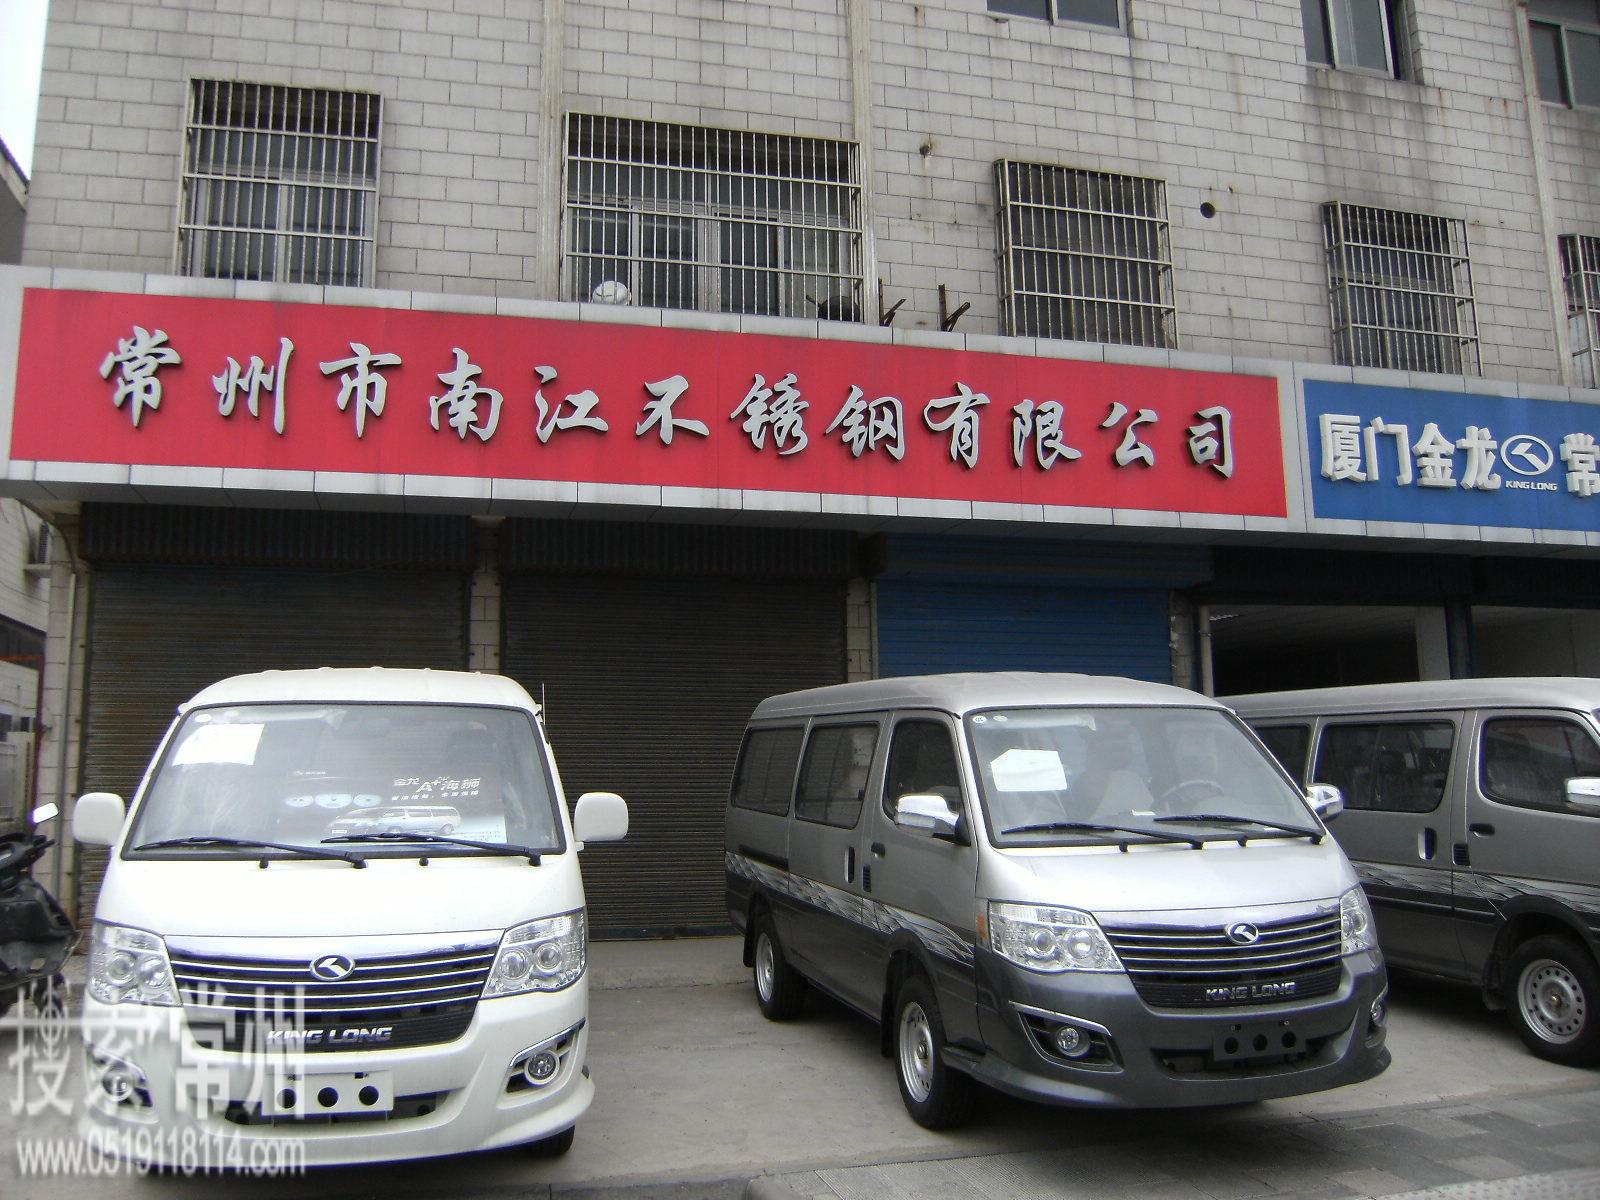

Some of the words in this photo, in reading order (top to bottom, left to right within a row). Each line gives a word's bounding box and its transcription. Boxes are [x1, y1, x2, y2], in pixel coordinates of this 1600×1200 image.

[99, 325, 1233, 479] 常州市南江不锈钢有限公司
[1319, 413, 1502, 490] 厦门金龙
[1505, 480, 1530, 489] KING
[1531, 482, 1558, 491] LONG
[1205, 986, 1248, 1001] KING
[1252, 982, 1297, 998] LONG
[266, 1029, 324, 1044] KING
[328, 1026, 393, 1043] LONG
